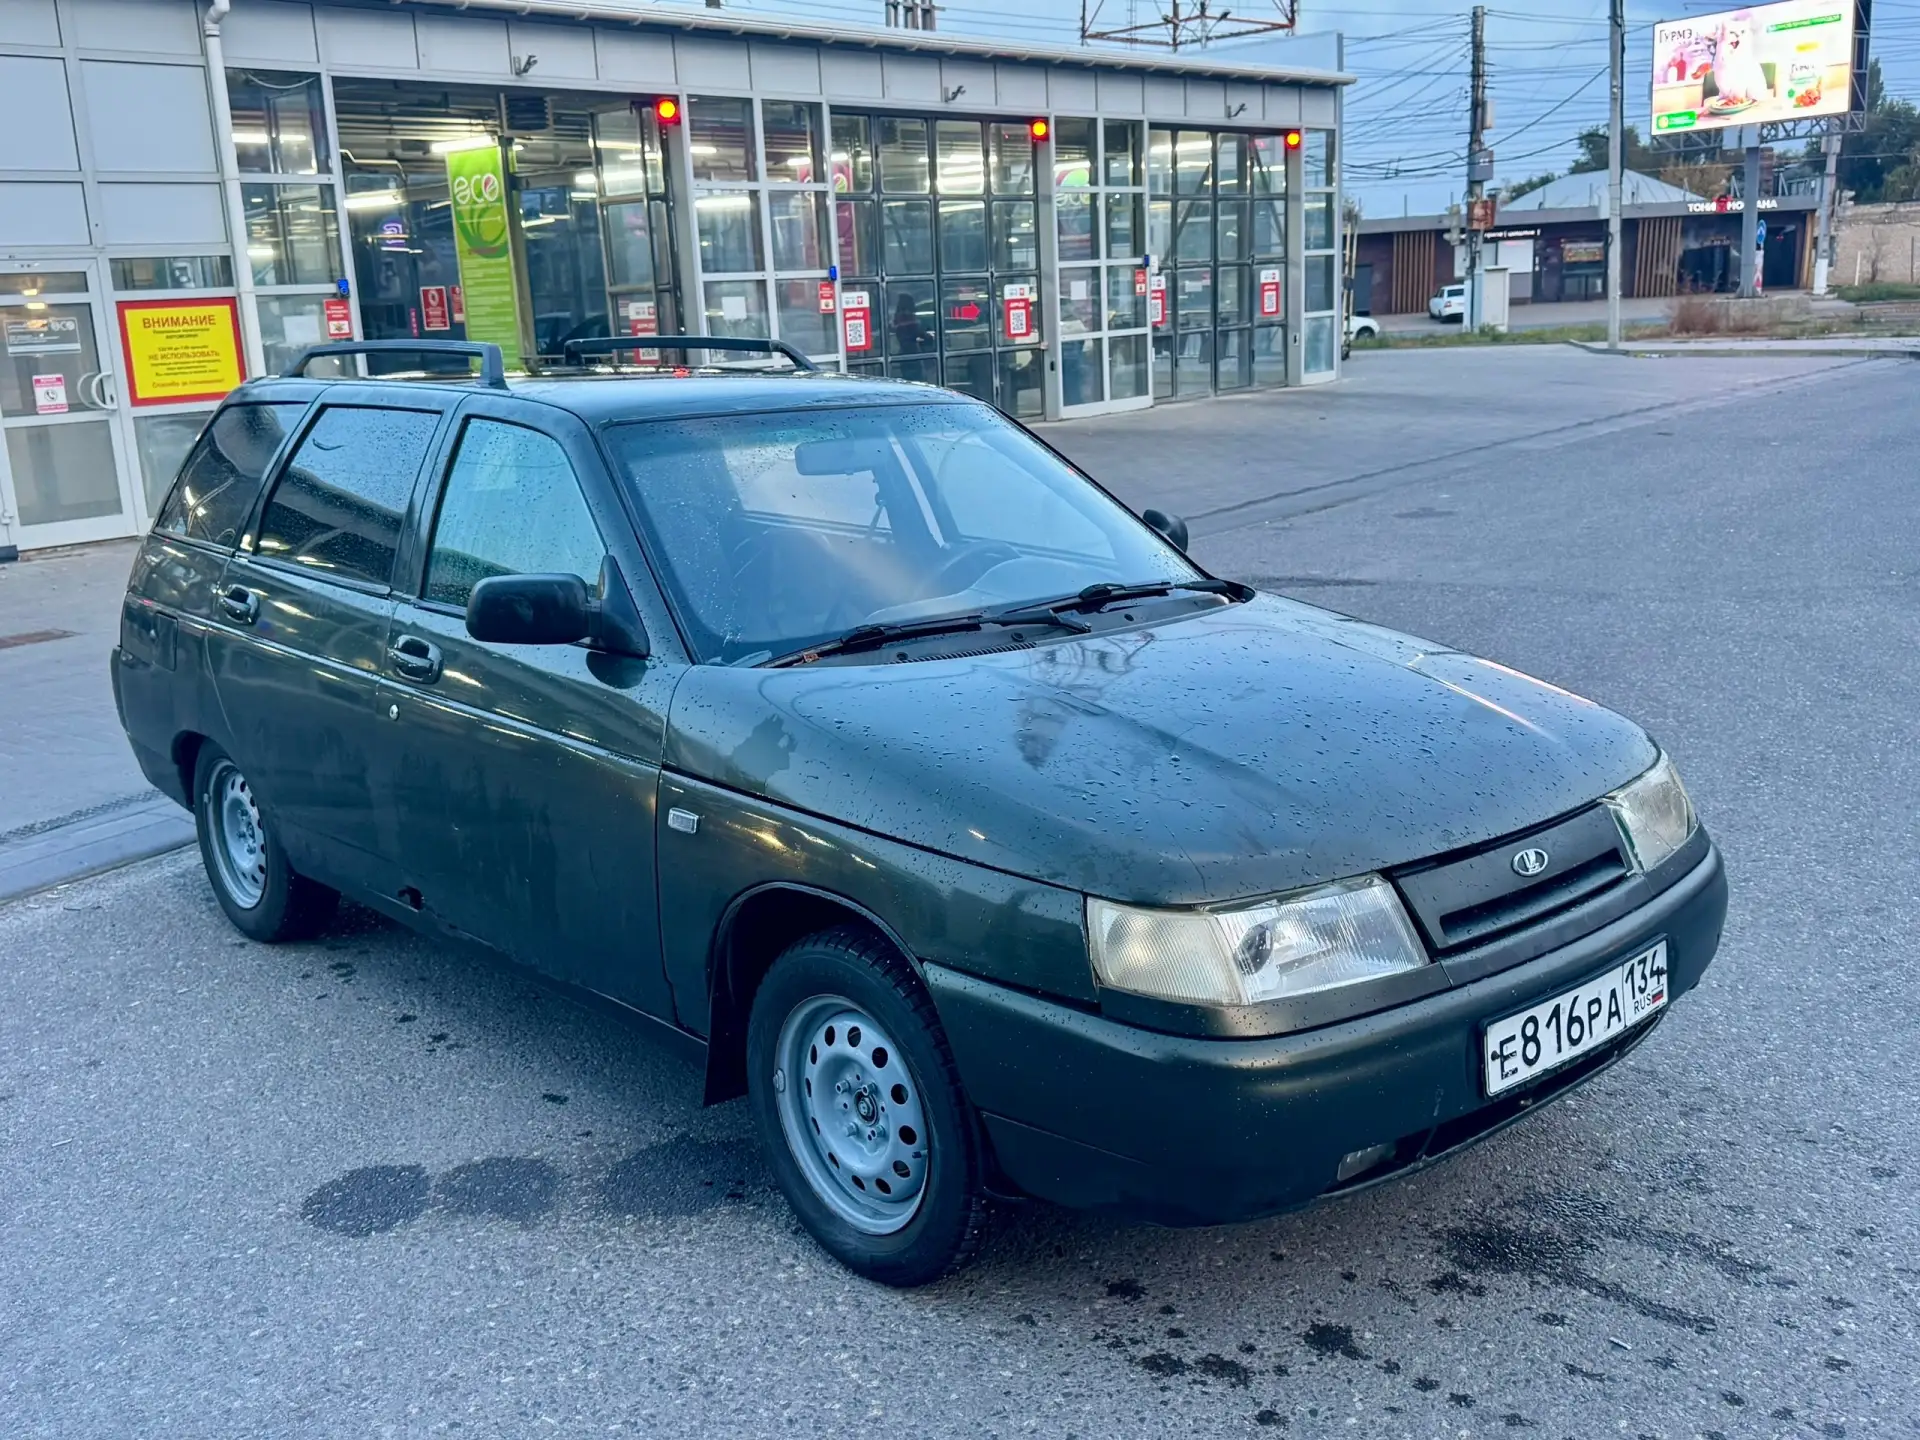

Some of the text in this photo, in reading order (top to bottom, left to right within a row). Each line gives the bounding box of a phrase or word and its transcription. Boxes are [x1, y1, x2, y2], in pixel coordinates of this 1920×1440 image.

[142, 315, 217, 329] ВНИМАНИЕ
[1498, 949, 1663, 1081] Е816РА 134
[1633, 992, 1652, 1015] RUS
